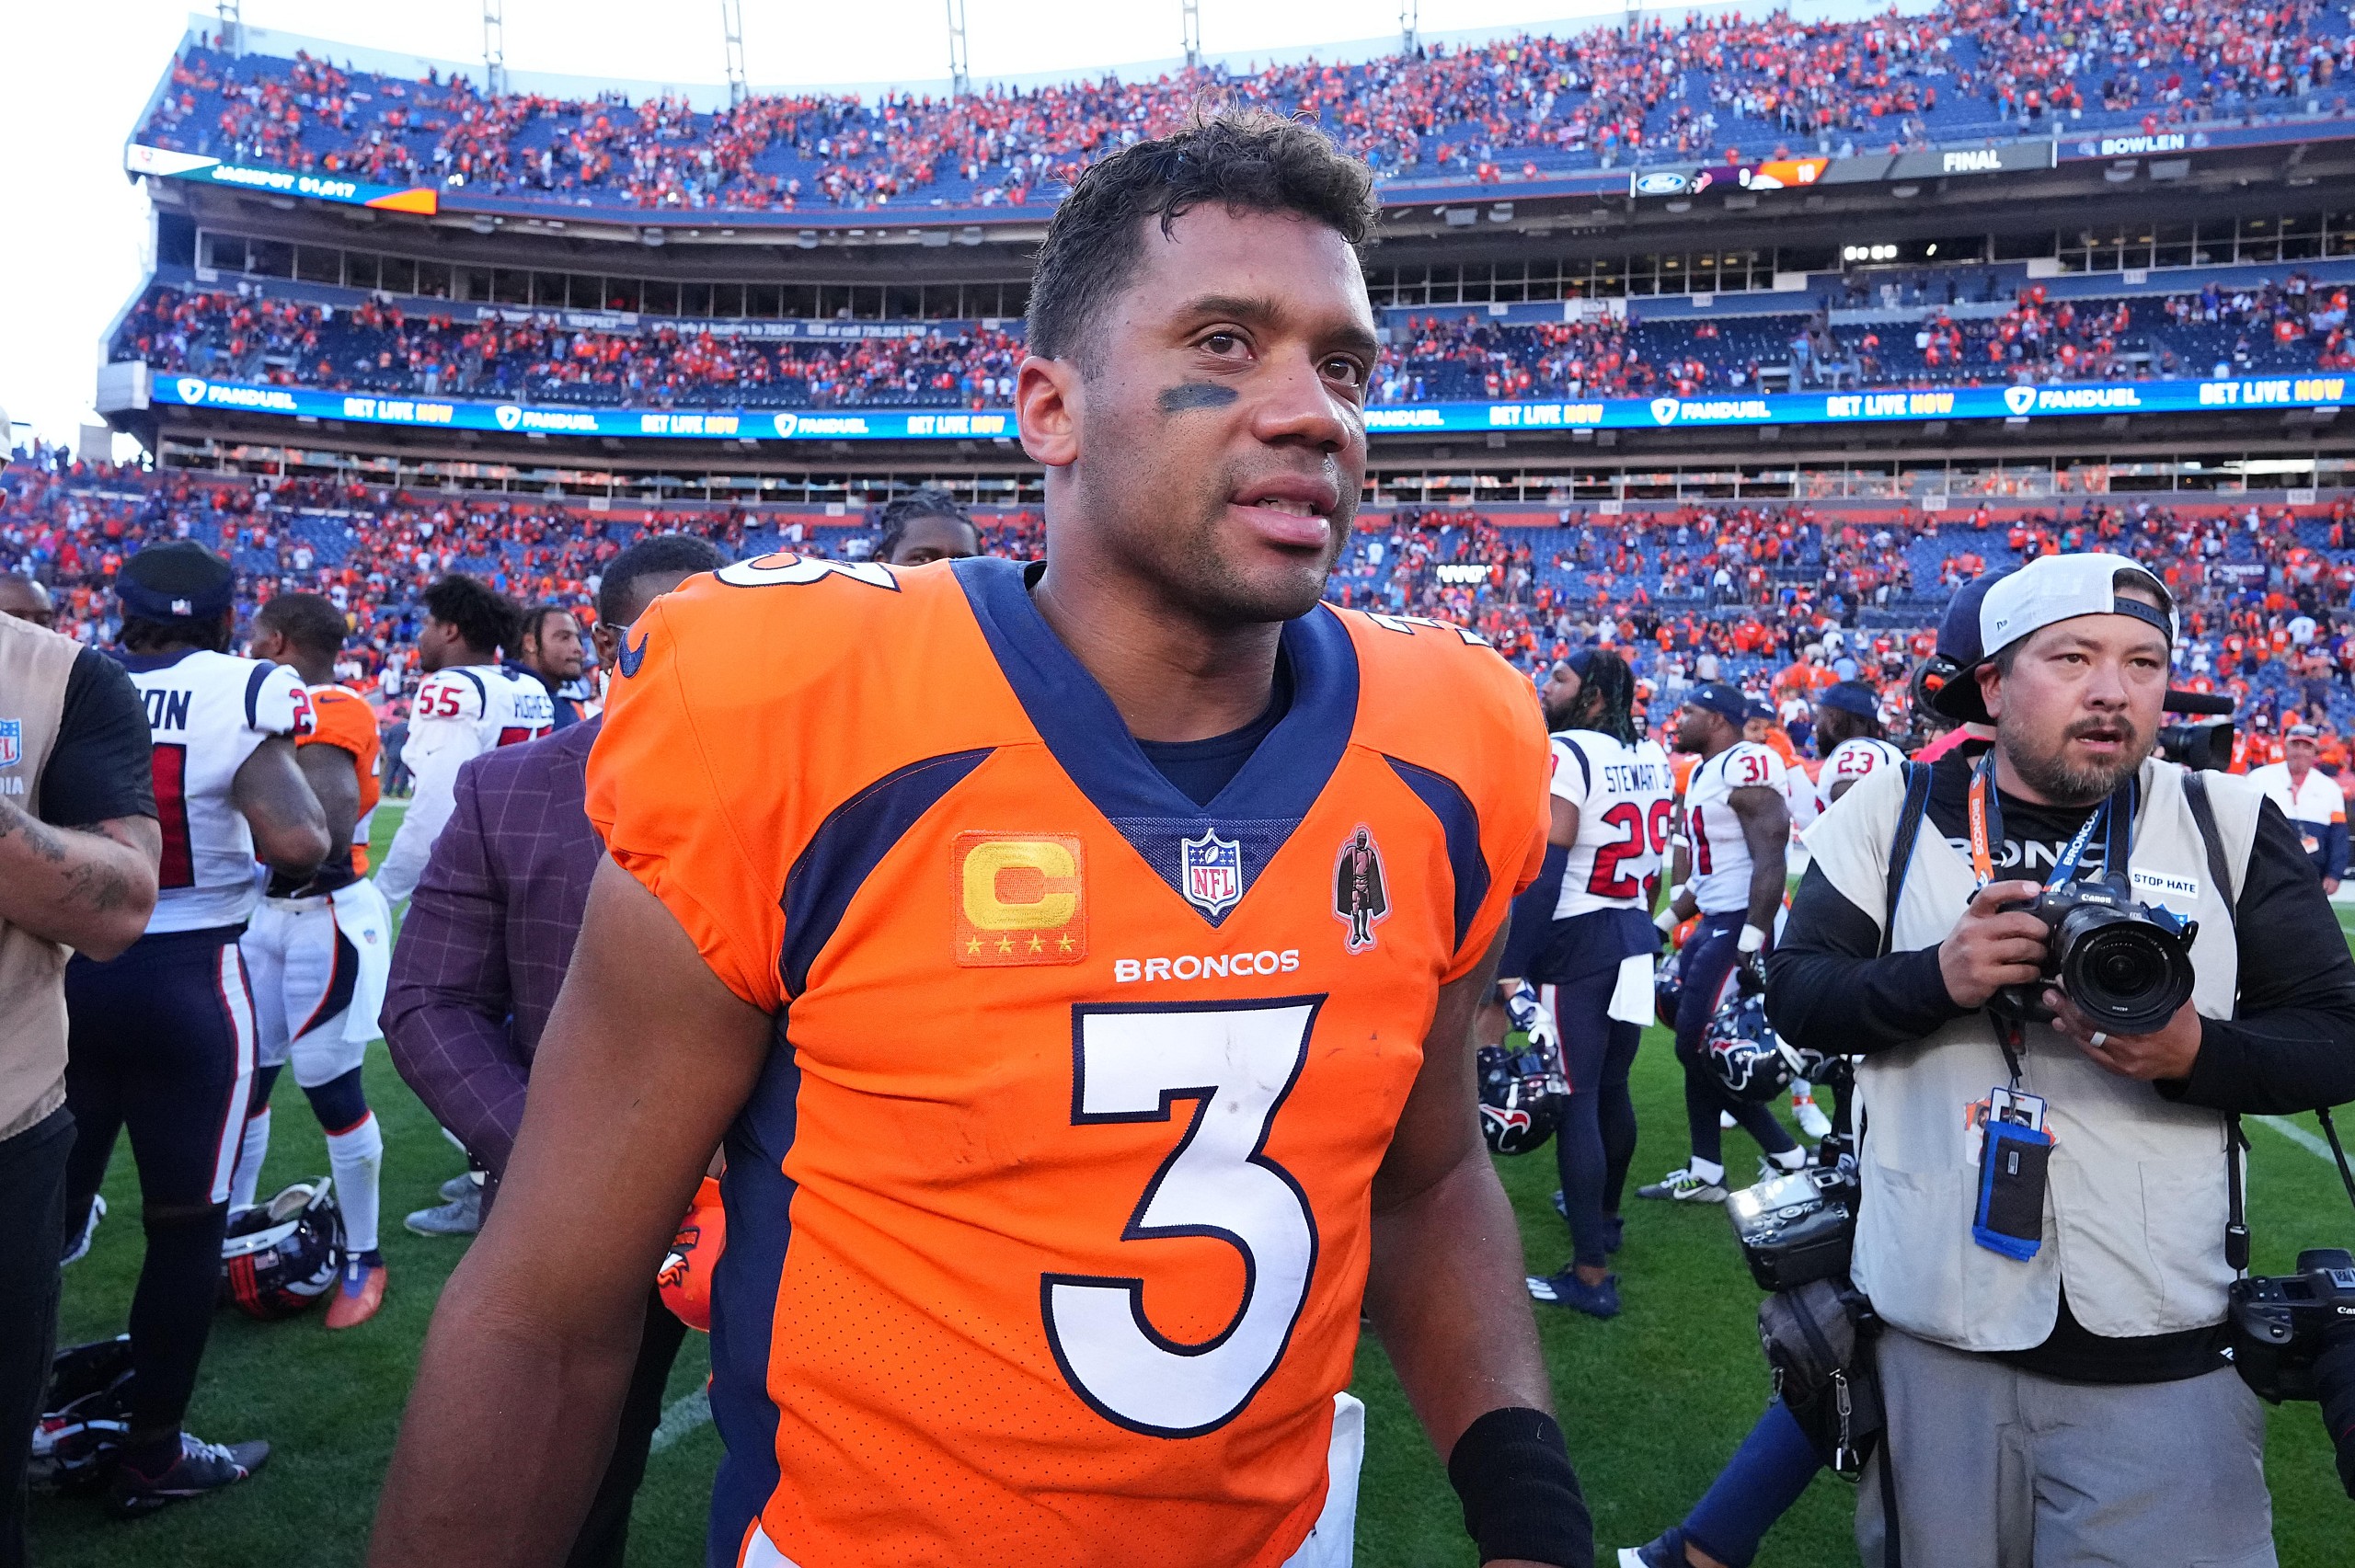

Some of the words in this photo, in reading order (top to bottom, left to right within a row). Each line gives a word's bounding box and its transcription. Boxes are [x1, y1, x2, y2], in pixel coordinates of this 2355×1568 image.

[2102, 133, 2185, 155] BOWLEN
[1944, 149, 2002, 172] FINAL
[209, 385, 296, 409] FANDUEL
[2039, 388, 2141, 409] FANDUEL
[2200, 382, 2238, 405] BET
[2243, 380, 2290, 403] LIVE
[2294, 379, 2345, 401] NOW
[344, 397, 375, 418] BET
[378, 401, 413, 421] LIVE
[416, 403, 453, 423] NOW
[1489, 406, 1522, 425] BET
[1523, 405, 1561, 424] LIVE
[1564, 404, 1603, 424] NOW
[1682, 401, 1771, 419] FANDUEL
[1827, 395, 1862, 417] BET
[1866, 394, 1907, 416] LIVE
[1910, 393, 1954, 414] NOW
[523, 411, 598, 430] FANDUEL
[641, 415, 669, 432] BET
[671, 416, 703, 433] LIVE
[705, 417, 739, 434] NOW
[798, 418, 868, 434] FANDUEL
[908, 416, 935, 434] BET
[936, 416, 970, 434] LIVE
[971, 416, 1005, 433] NOW
[136, 689, 192, 730] ON
[419, 685, 464, 716] 55
[1739, 755, 1768, 782] 31
[1838, 751, 1874, 774] 23
[1604, 765, 1658, 793] STEWART
[1971, 797, 1984, 856] BRONCOS
[962, 841, 1078, 931] C
[1193, 868, 1235, 899] NFL
[2134, 874, 2164, 887] STOP
[2166, 879, 2196, 893] HATE
[2081, 893, 2111, 904] Canon
[1114, 949, 1300, 983] BRONCOS
[1040, 992, 1329, 1439] 3
